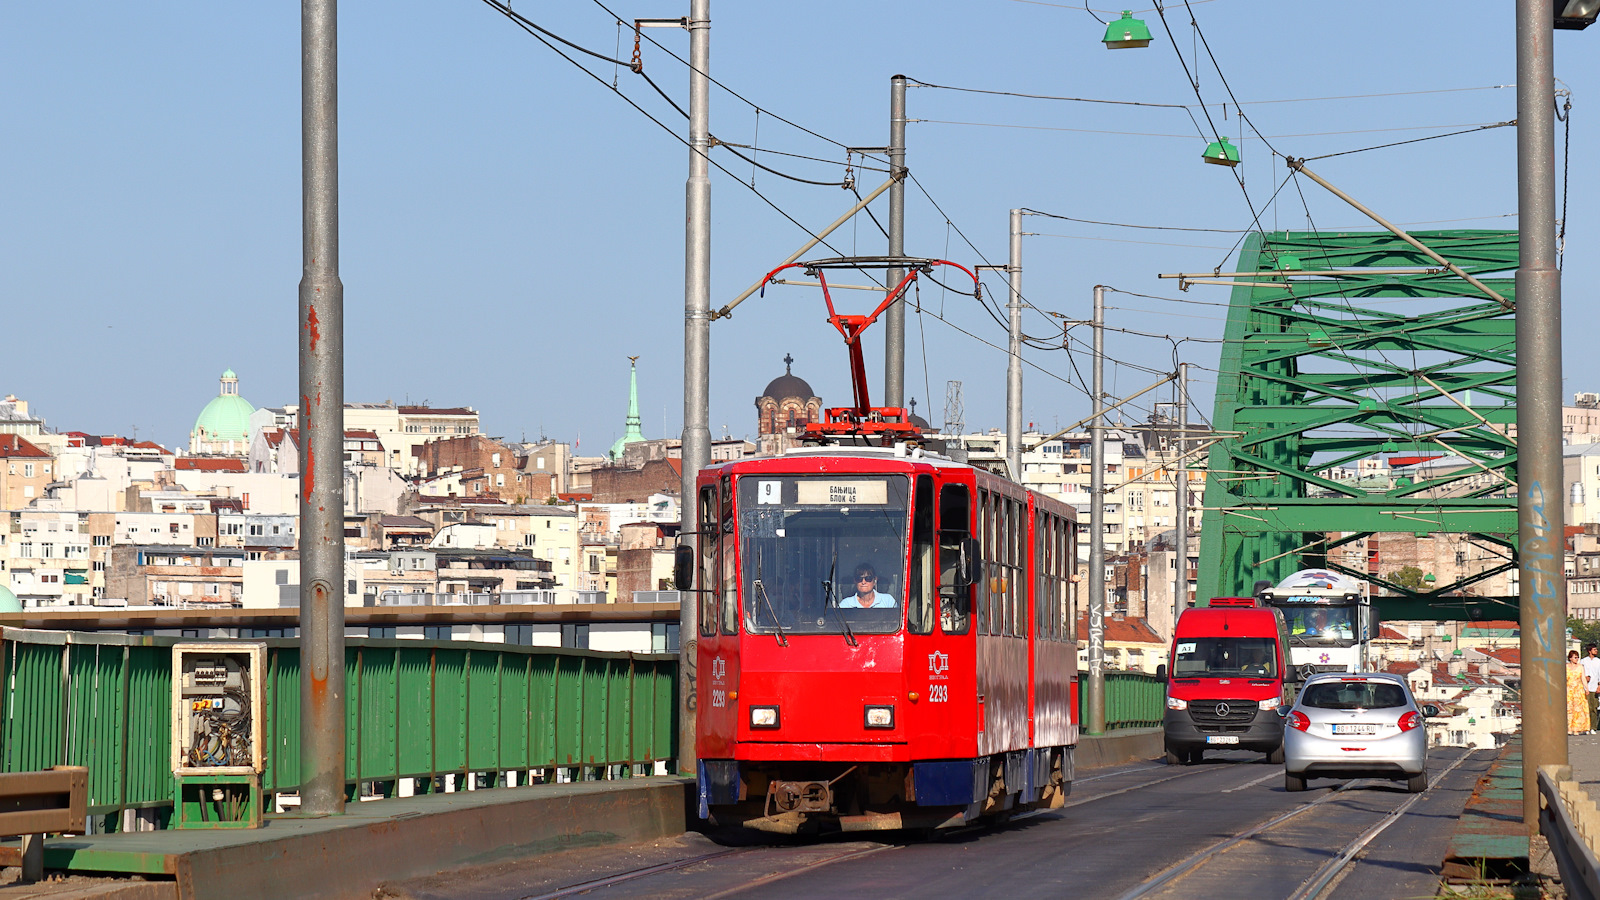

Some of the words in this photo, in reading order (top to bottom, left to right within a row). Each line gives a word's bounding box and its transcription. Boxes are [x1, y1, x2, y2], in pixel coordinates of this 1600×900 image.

[765, 483, 772, 496] 9
[829, 485, 857, 494] БАЊИЦА
[829, 494, 846, 503] БЛОК
[848, 495, 856, 503] 45
[712, 689, 726, 708] 2293
[929, 684, 948, 703] 2293
[1336, 724, 1345, 732] BG
[1366, 724, 1375, 732] RU
